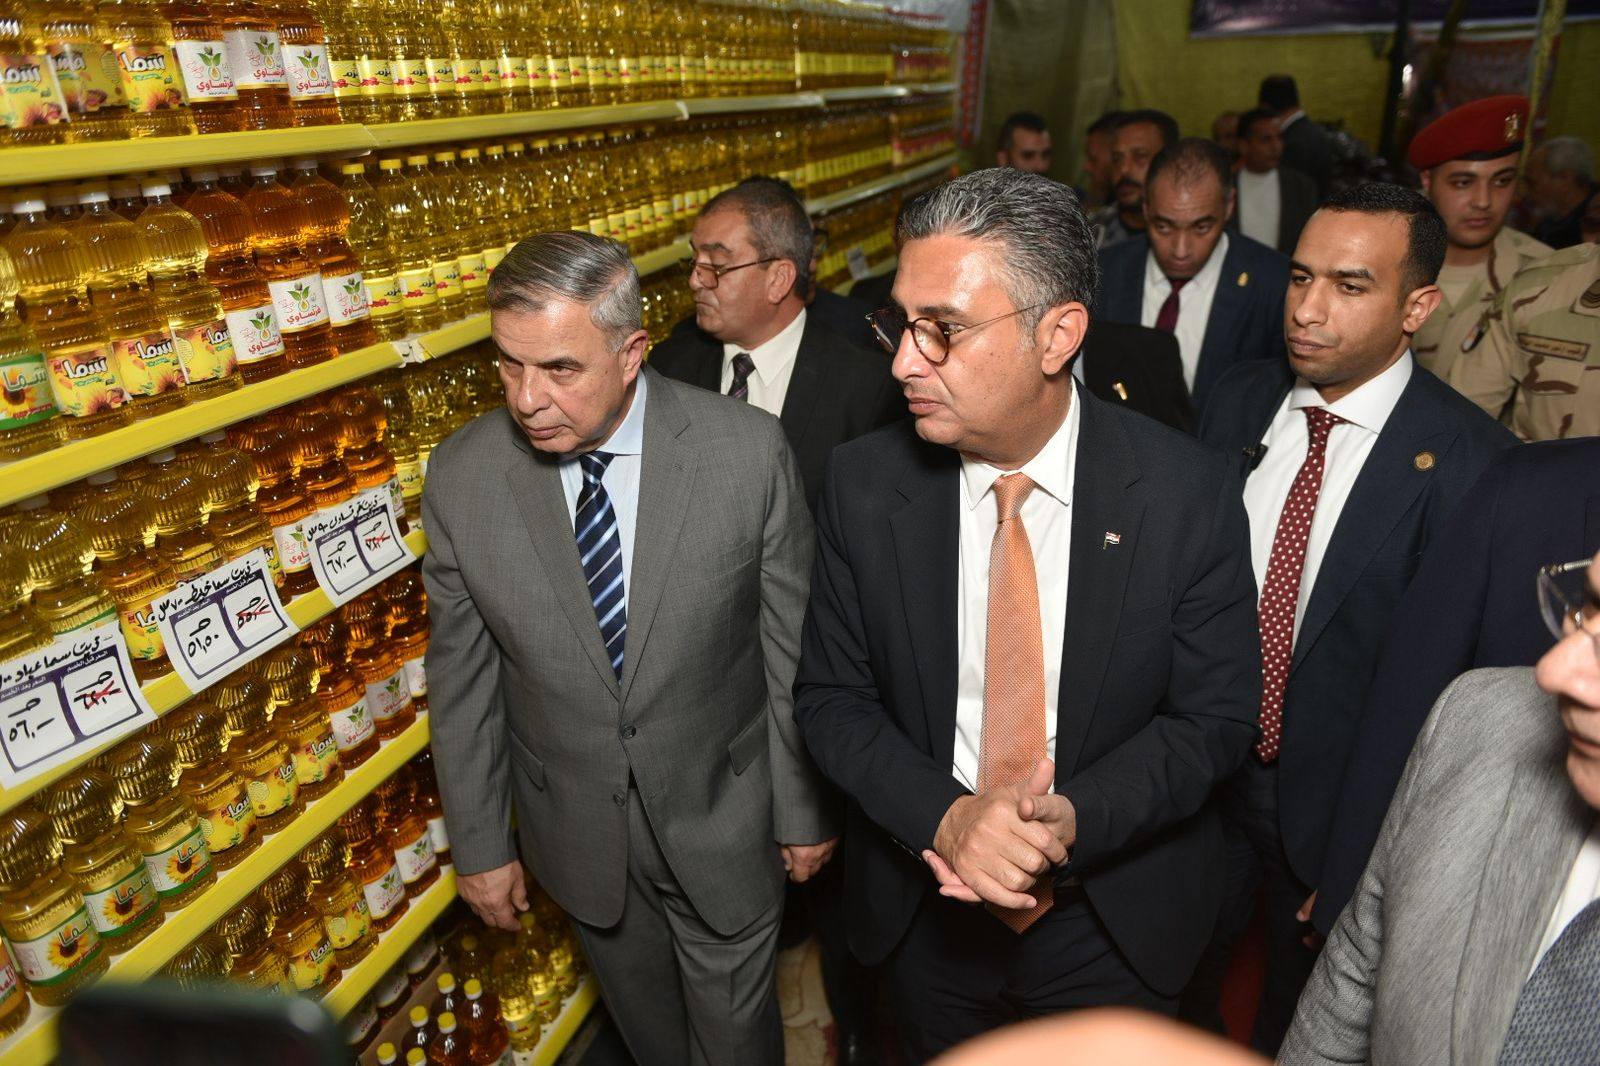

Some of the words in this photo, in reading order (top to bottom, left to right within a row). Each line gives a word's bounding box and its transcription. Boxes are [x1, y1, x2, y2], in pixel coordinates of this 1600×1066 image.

[119, 51, 166, 72] سما
[196, 78, 234, 93] فرنساوي
[287, 305, 322, 325] فرنساوي
[61, 355, 108, 380] سما
[73, 635, 101, 659] زيت
[44, 651, 72, 668] سما
